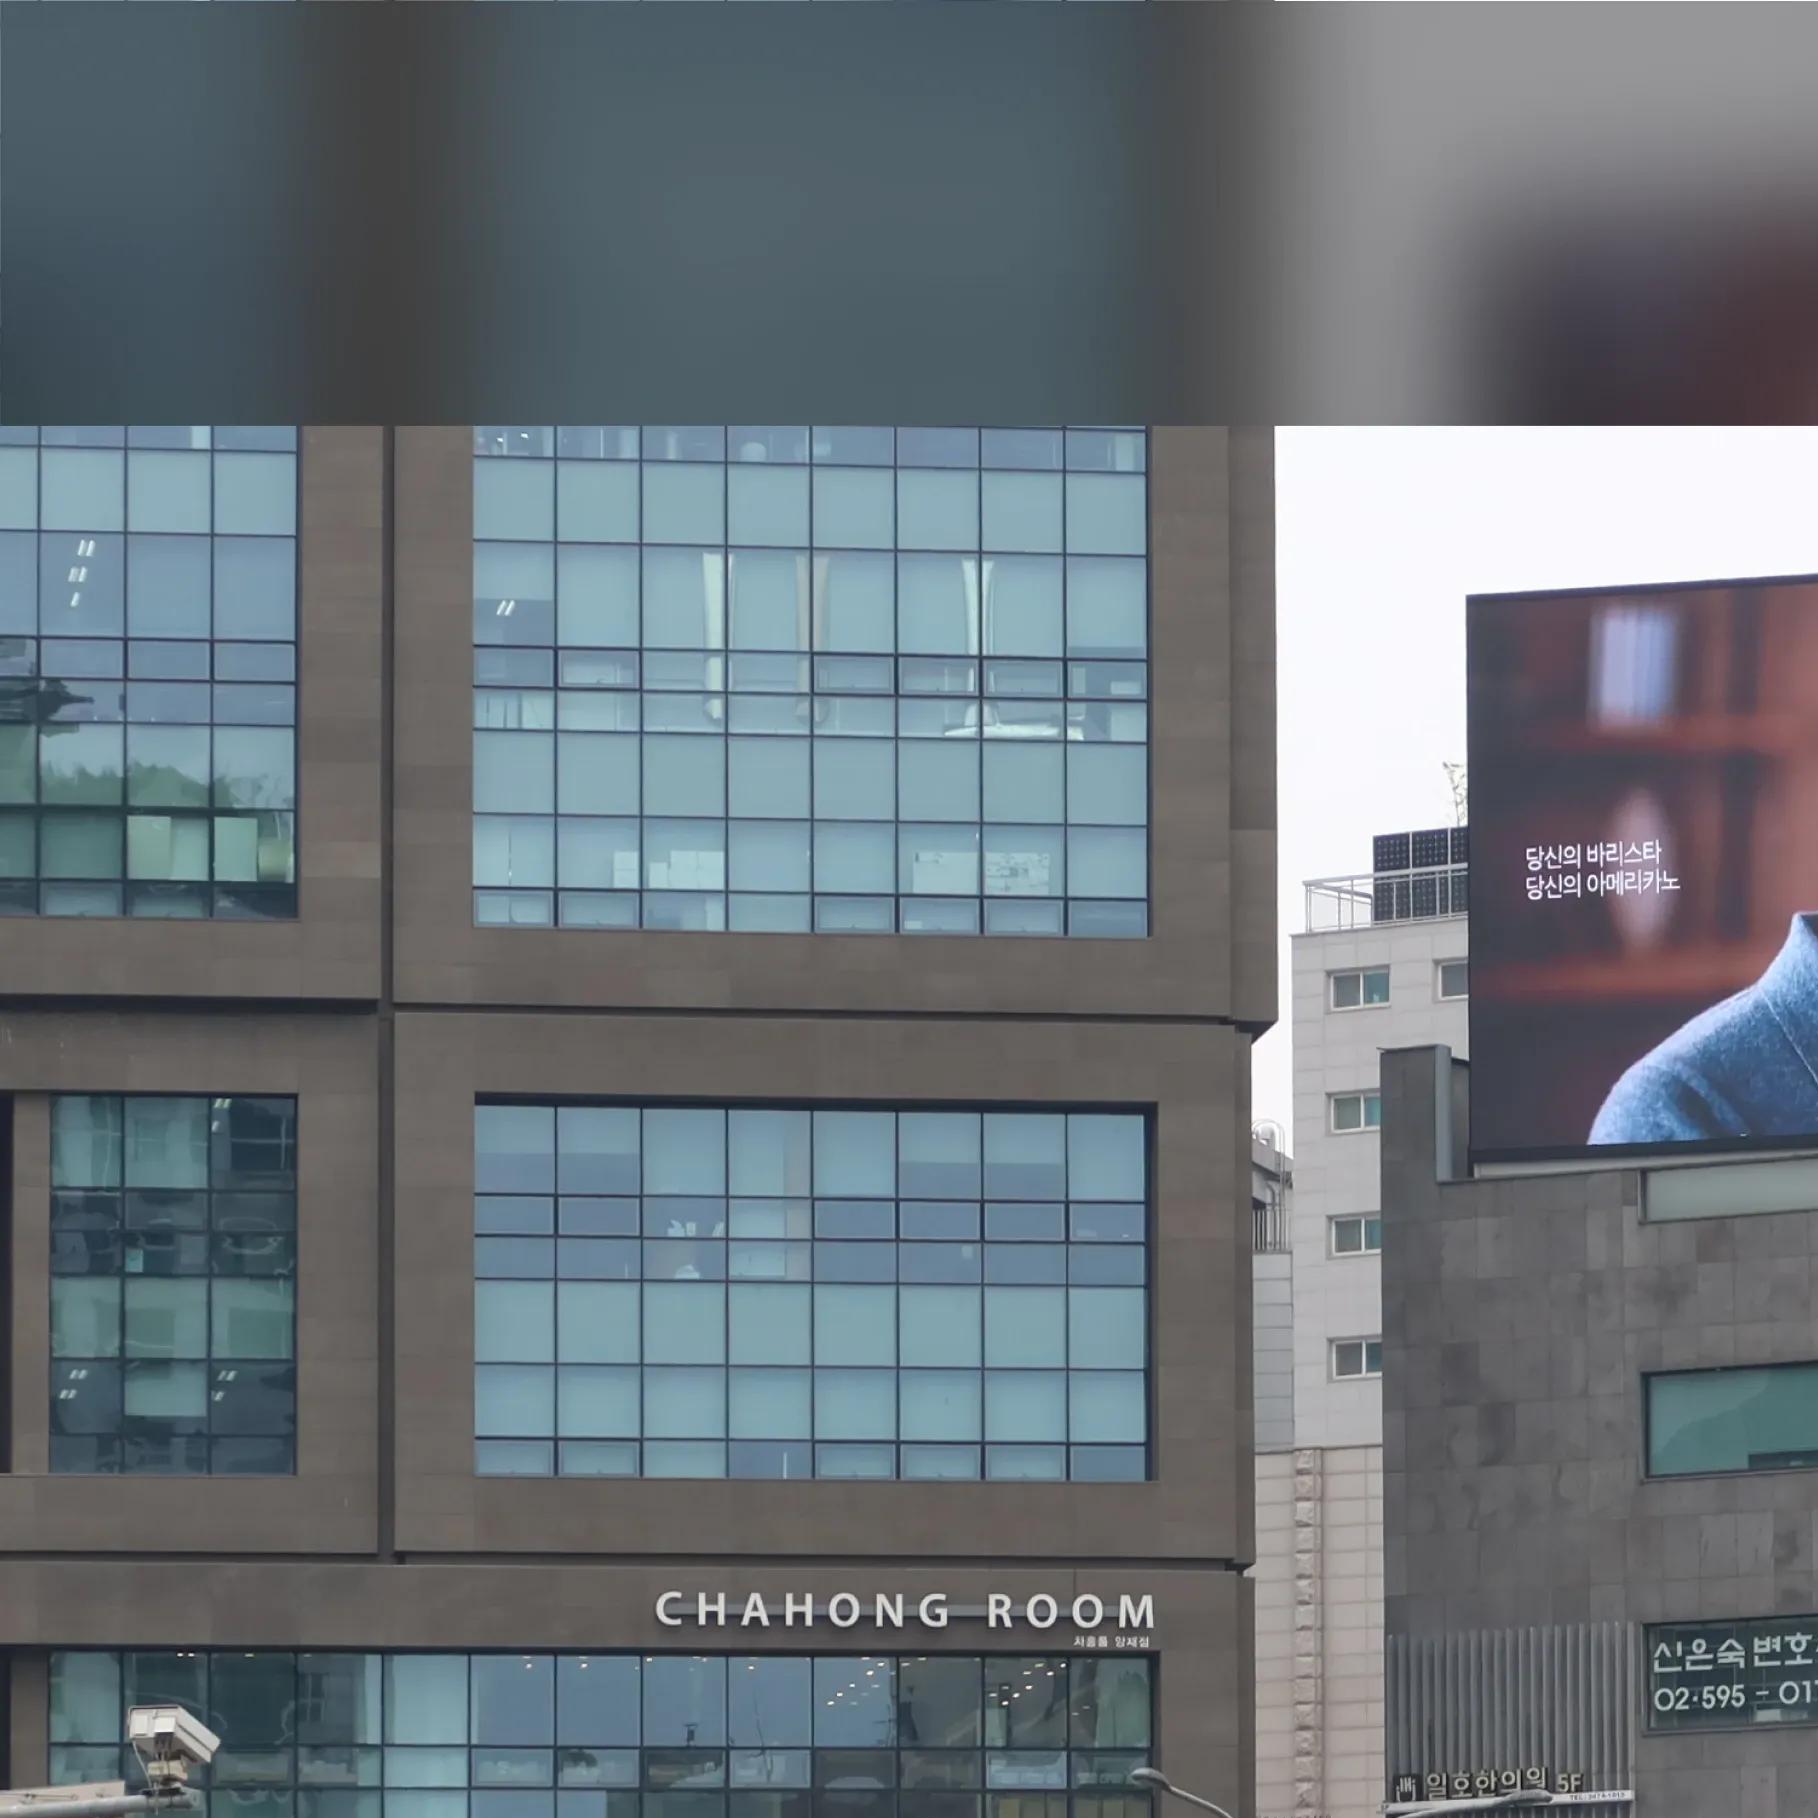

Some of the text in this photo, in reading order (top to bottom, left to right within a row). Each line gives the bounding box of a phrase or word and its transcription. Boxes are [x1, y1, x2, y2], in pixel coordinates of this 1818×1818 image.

[1526, 839, 1662, 871] 당신의 바리스타
[1526, 868, 1681, 900] 당신의 아메리카노
[655, 1590, 1155, 1629] CHAHONG ROOM
[1653, 1637, 1746, 1674] 신은숙
[1557, 1773, 1584, 1793] 5F
